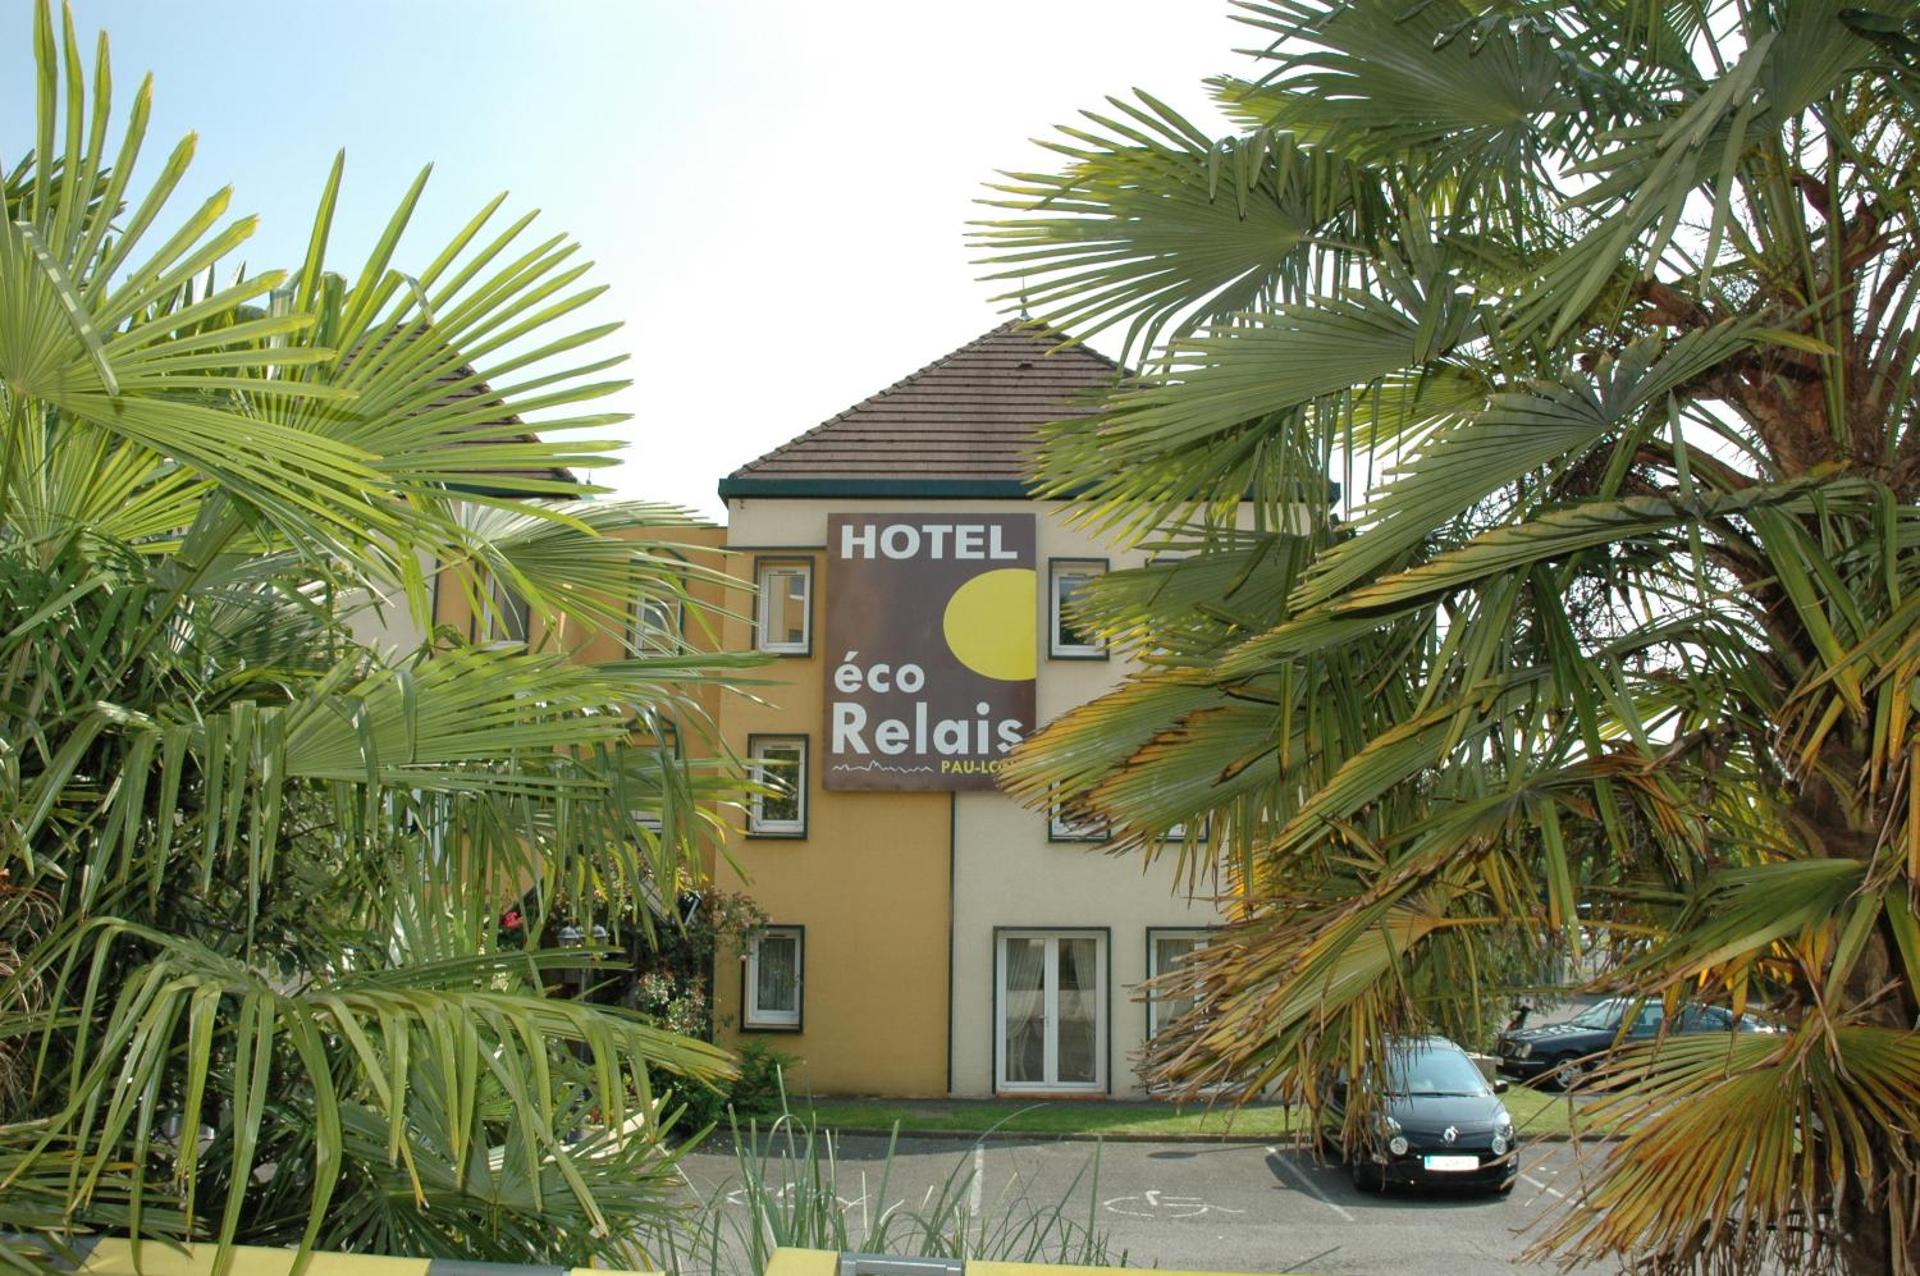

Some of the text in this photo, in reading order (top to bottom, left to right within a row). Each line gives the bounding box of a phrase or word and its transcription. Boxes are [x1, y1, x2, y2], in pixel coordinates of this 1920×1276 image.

[841, 525, 1017, 559] HOTEL
[834, 651, 925, 693] éco
[832, 702, 1023, 754] Relais
[941, 760, 1004, 774] PAU-LO
